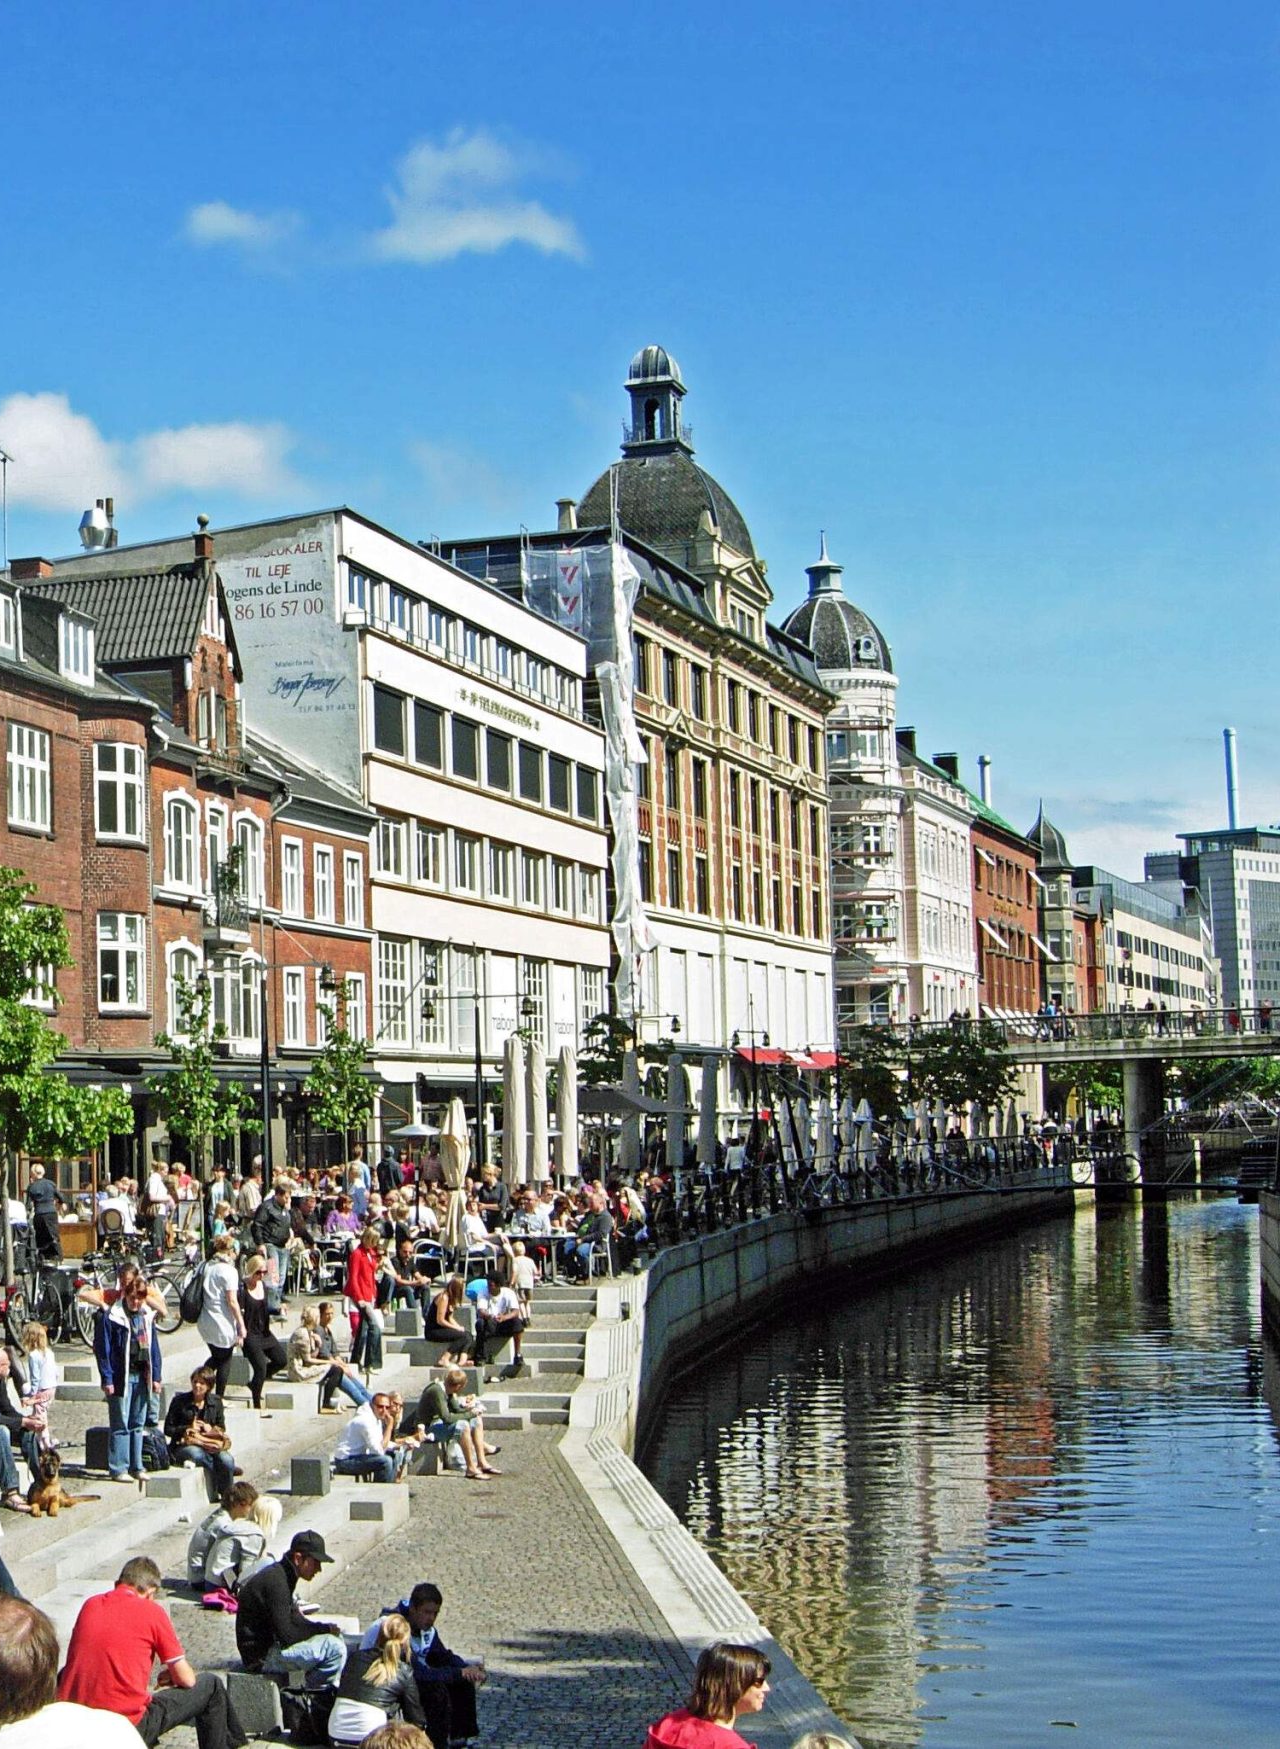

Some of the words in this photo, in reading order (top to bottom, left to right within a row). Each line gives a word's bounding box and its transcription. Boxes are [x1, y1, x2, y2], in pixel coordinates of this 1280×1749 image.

[245, 567, 261, 578] TIL
[268, 564, 291, 579] LEJE
[223, 585, 263, 601] ogens
[266, 582, 281, 595] de
[285, 579, 322, 594] Linde
[235, 603, 255, 621] 86
[260, 602, 276, 619] 16
[281, 600, 299, 617] 57
[304, 597, 324, 615] 00
